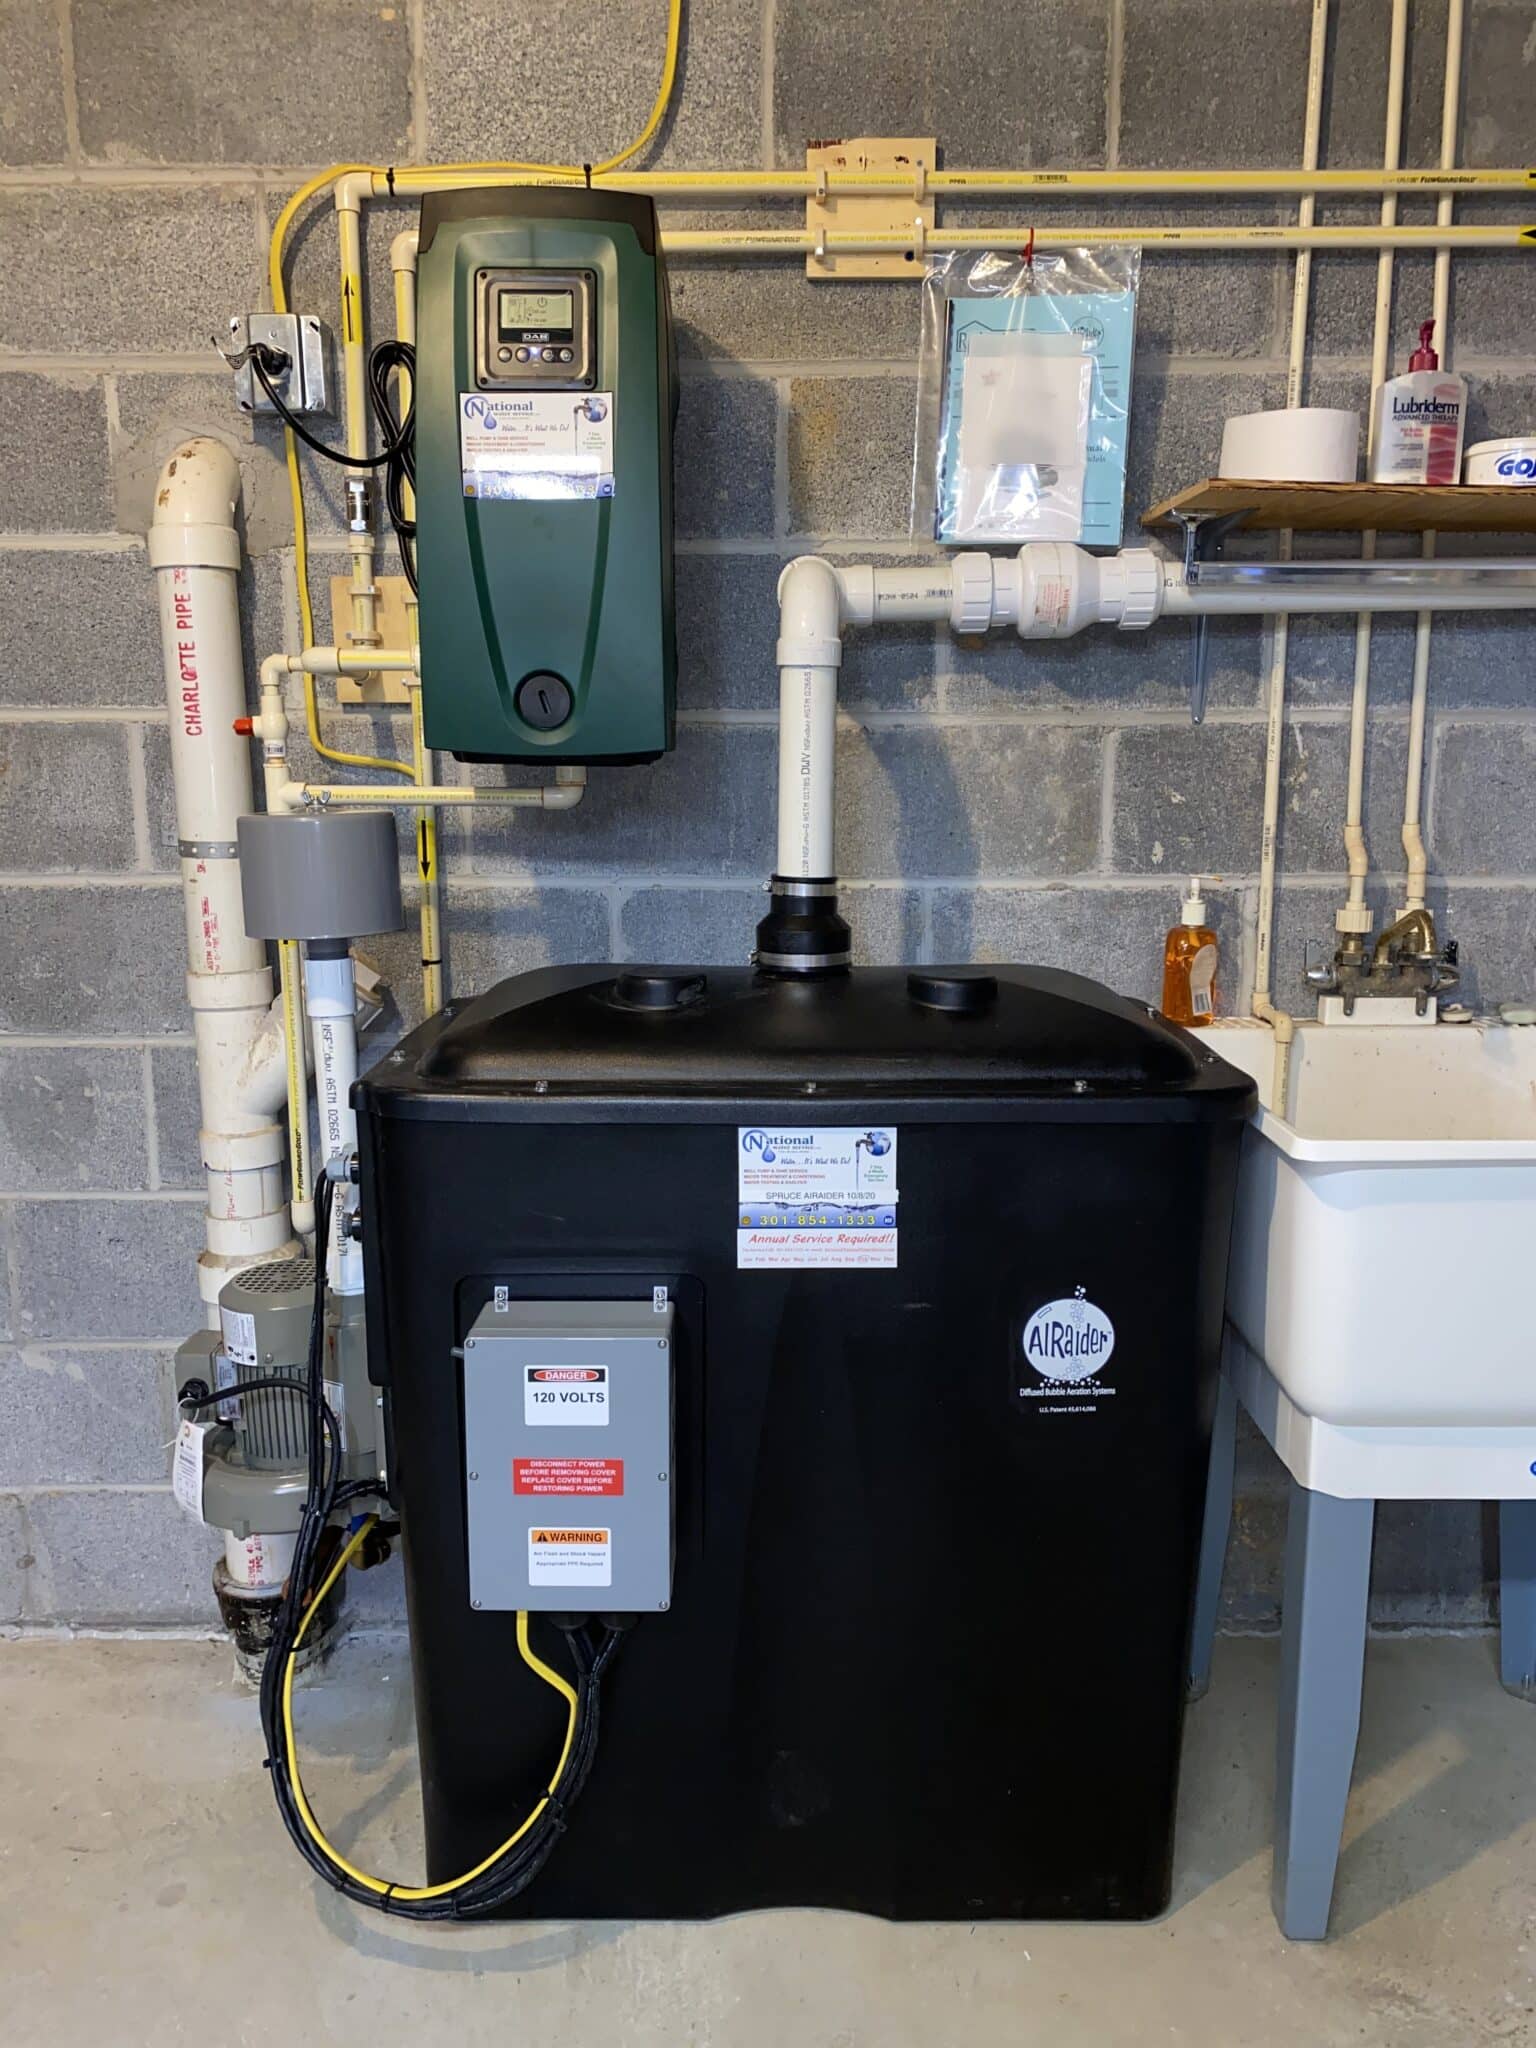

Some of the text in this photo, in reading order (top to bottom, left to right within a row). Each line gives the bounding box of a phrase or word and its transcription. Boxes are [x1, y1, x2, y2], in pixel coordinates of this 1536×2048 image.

[471, 401, 533, 417] National
[1393, 397, 1459, 415] Lubriderm
[174, 593, 194, 630] PIPE
[178, 641, 203, 736] CHARLOTTE
[801, 753, 811, 775] DWV
[326, 1079, 337, 1104] ASTM
[328, 1109, 340, 1141] D2665
[749, 1134, 814, 1150] National
[749, 1233, 895, 1246] Annual Service Required!!
[1029, 1321, 1108, 1358] AIRaider
[544, 1372, 587, 1380] DANGER
[532, 1392, 605, 1403] 120 VOLTS
[1020, 1388, 1116, 1396] Diffused Bubble Aeration Systems
[550, 1533, 602, 1542] WARNING
